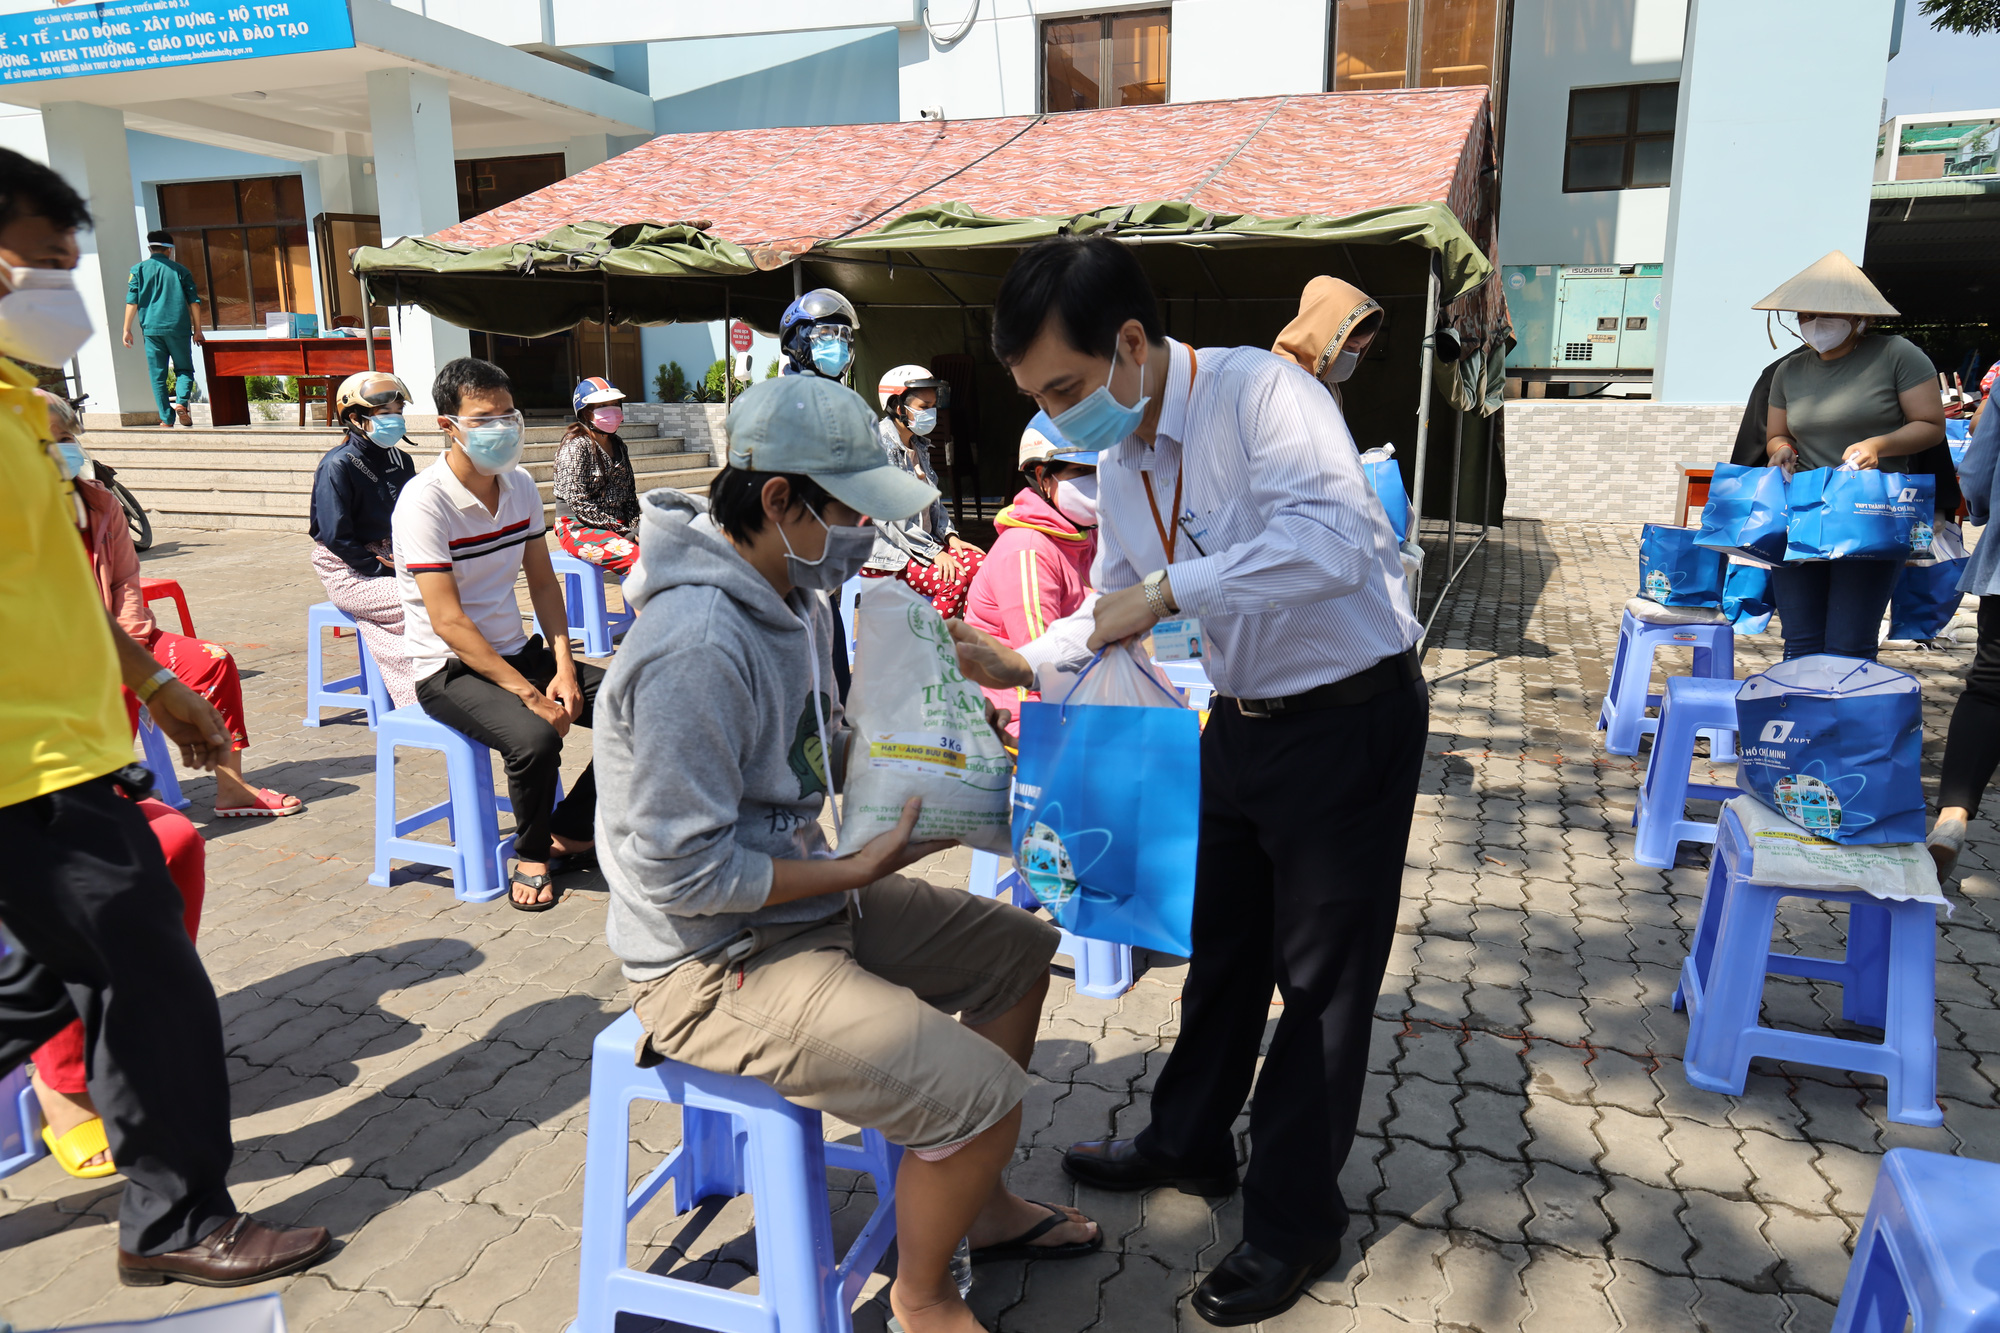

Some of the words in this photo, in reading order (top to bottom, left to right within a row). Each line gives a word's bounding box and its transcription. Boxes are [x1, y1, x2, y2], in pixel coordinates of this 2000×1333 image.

[19, 34, 28, 47] Y
[31, 27, 50, 45] TẾ
[62, 27, 89, 42] LAO
[91, 22, 132, 40] ĐỘNG
[142, 15, 170, 33] XÂY
[174, 11, 216, 29] DỰNG
[228, 5, 250, 23] HỘ
[253, 3, 289, 21] TỊCH
[40, 48, 78, 63] KHEN
[79, 39, 137, 60] THƯỞNG
[148, 34, 182, 52] GIÁO
[184, 32, 216, 48] DỤC
[218, 27, 239, 43] VÀ
[242, 24, 274, 41] ĐÀO
[277, 21, 309, 38] TẠO
[1788, 736, 1811, 744] VNPT
[1769, 750, 1786, 759] MINH
